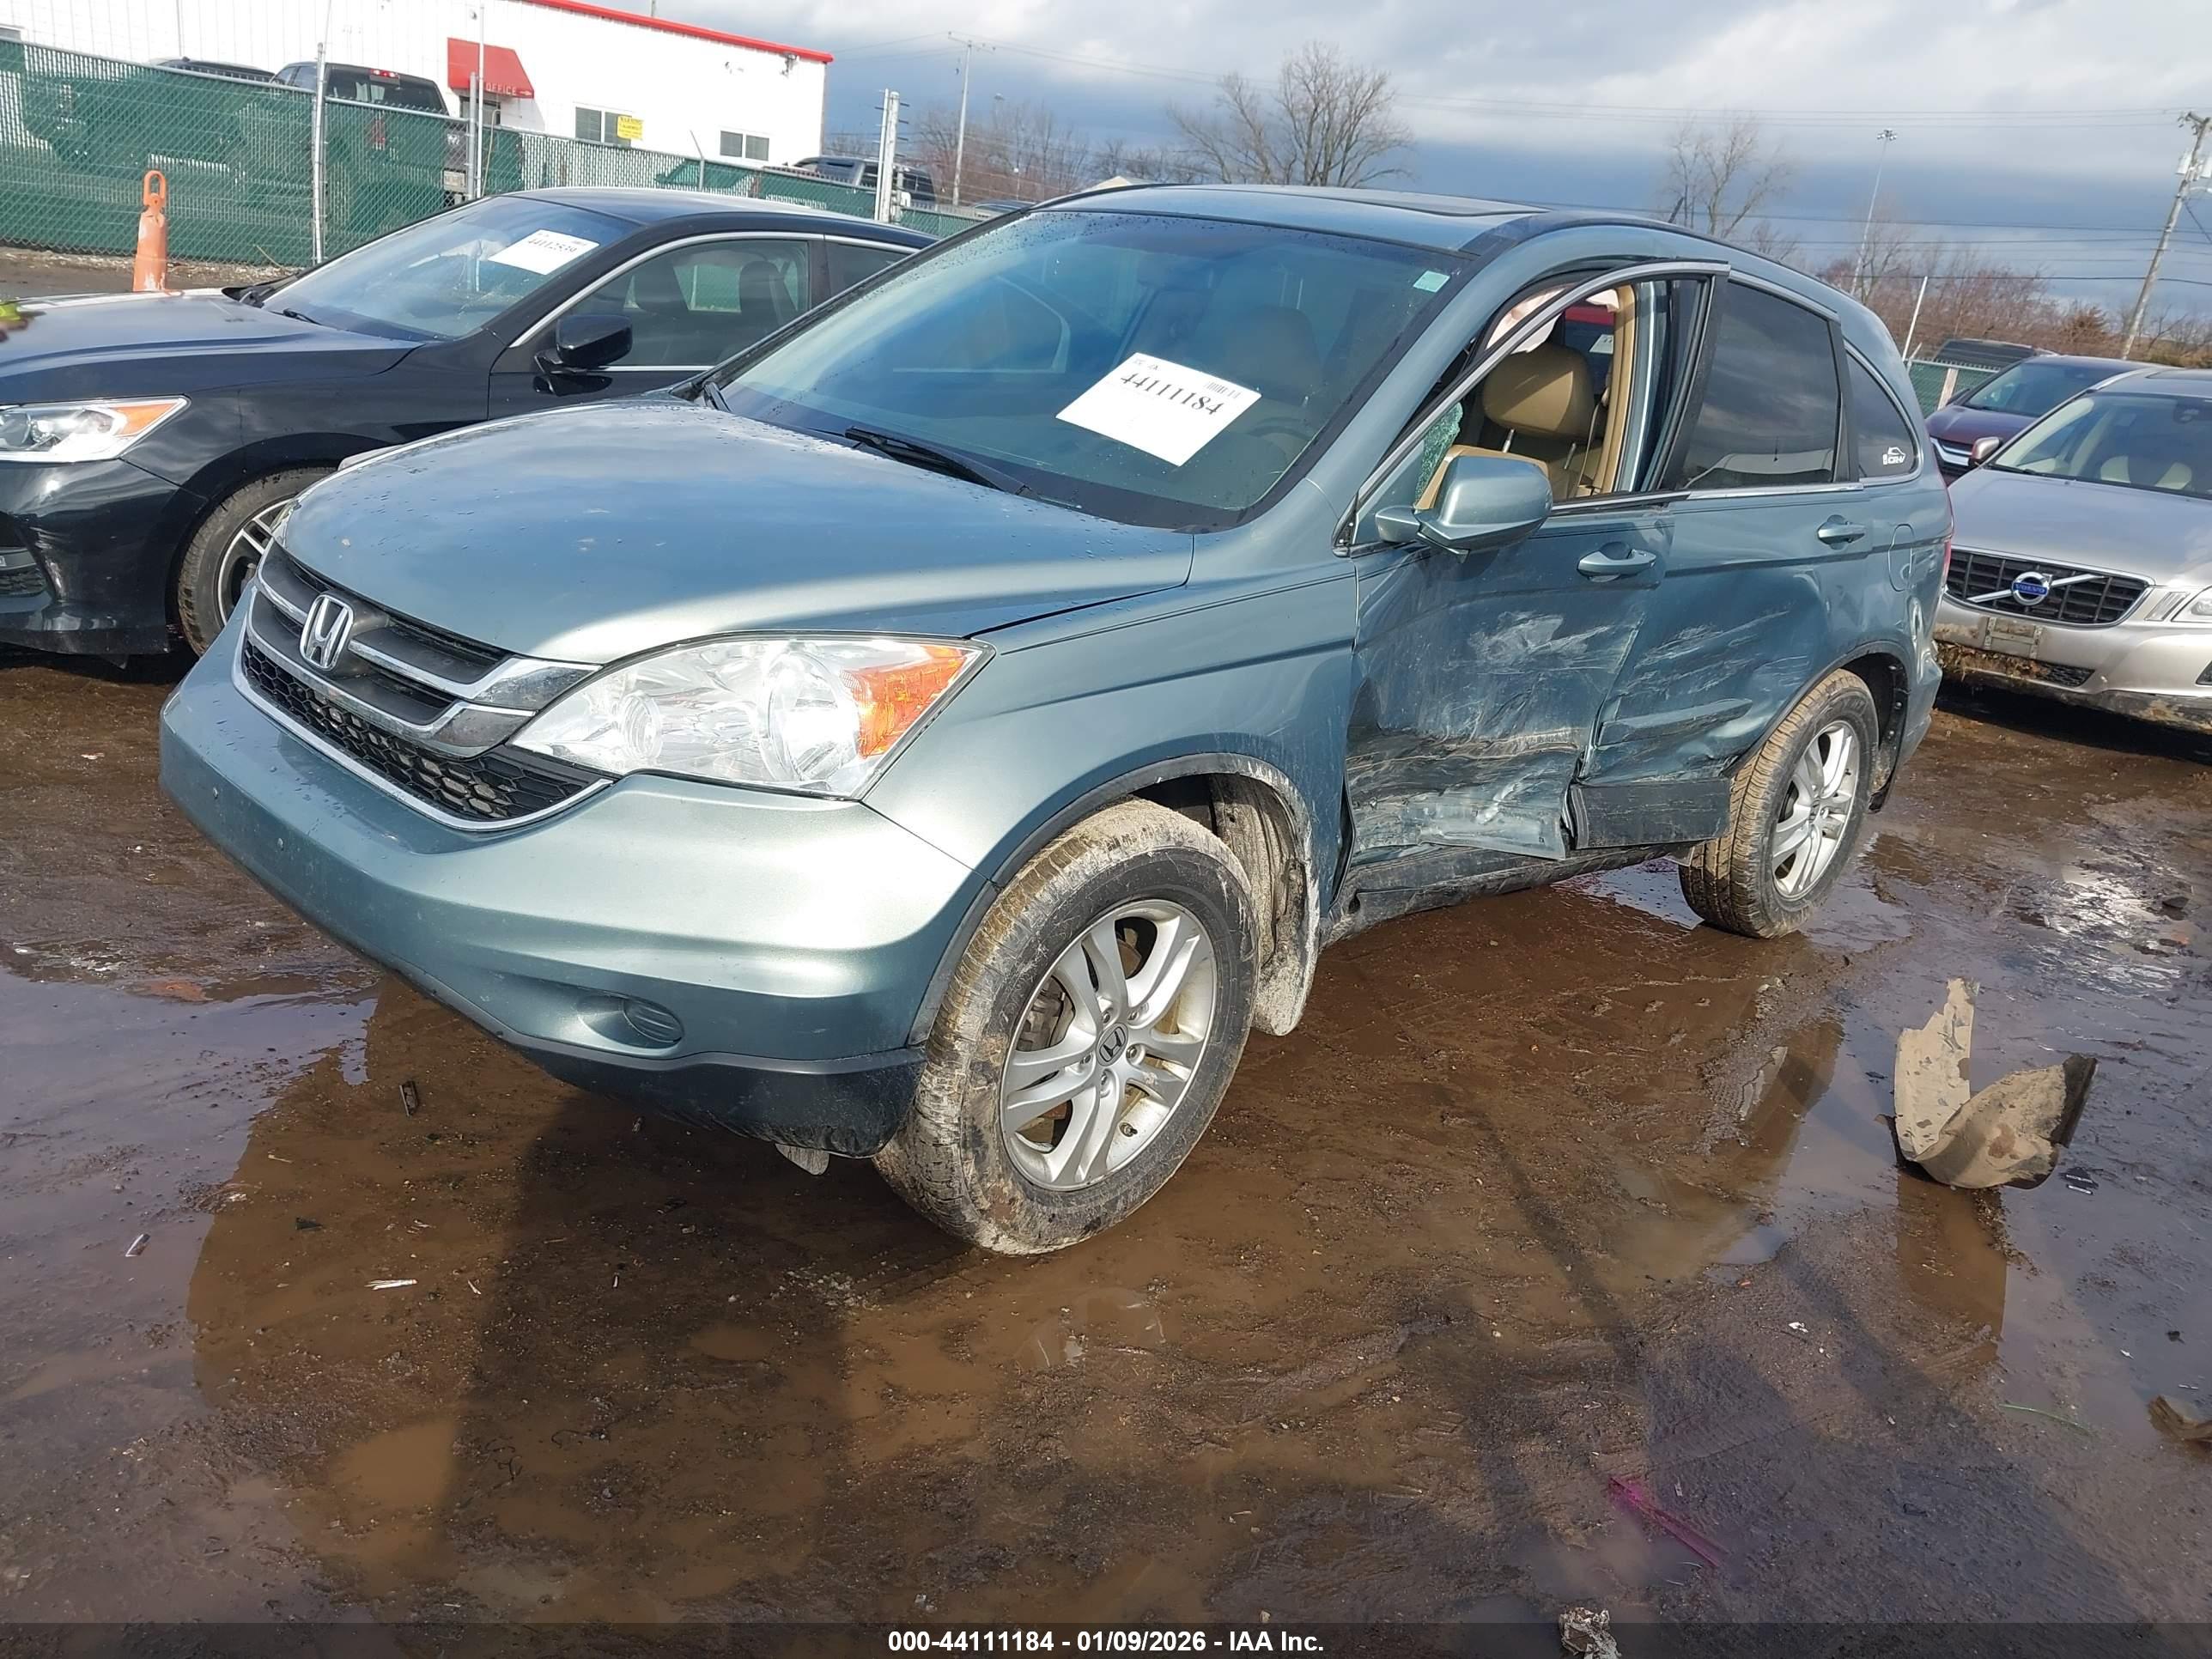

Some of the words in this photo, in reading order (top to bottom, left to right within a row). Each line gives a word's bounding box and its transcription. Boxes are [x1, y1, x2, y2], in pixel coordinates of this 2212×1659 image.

[486, 83, 517, 95] OFFICE
[1120, 373, 1224, 415] 44111184
[2014, 583, 2045, 594] VOLVO
